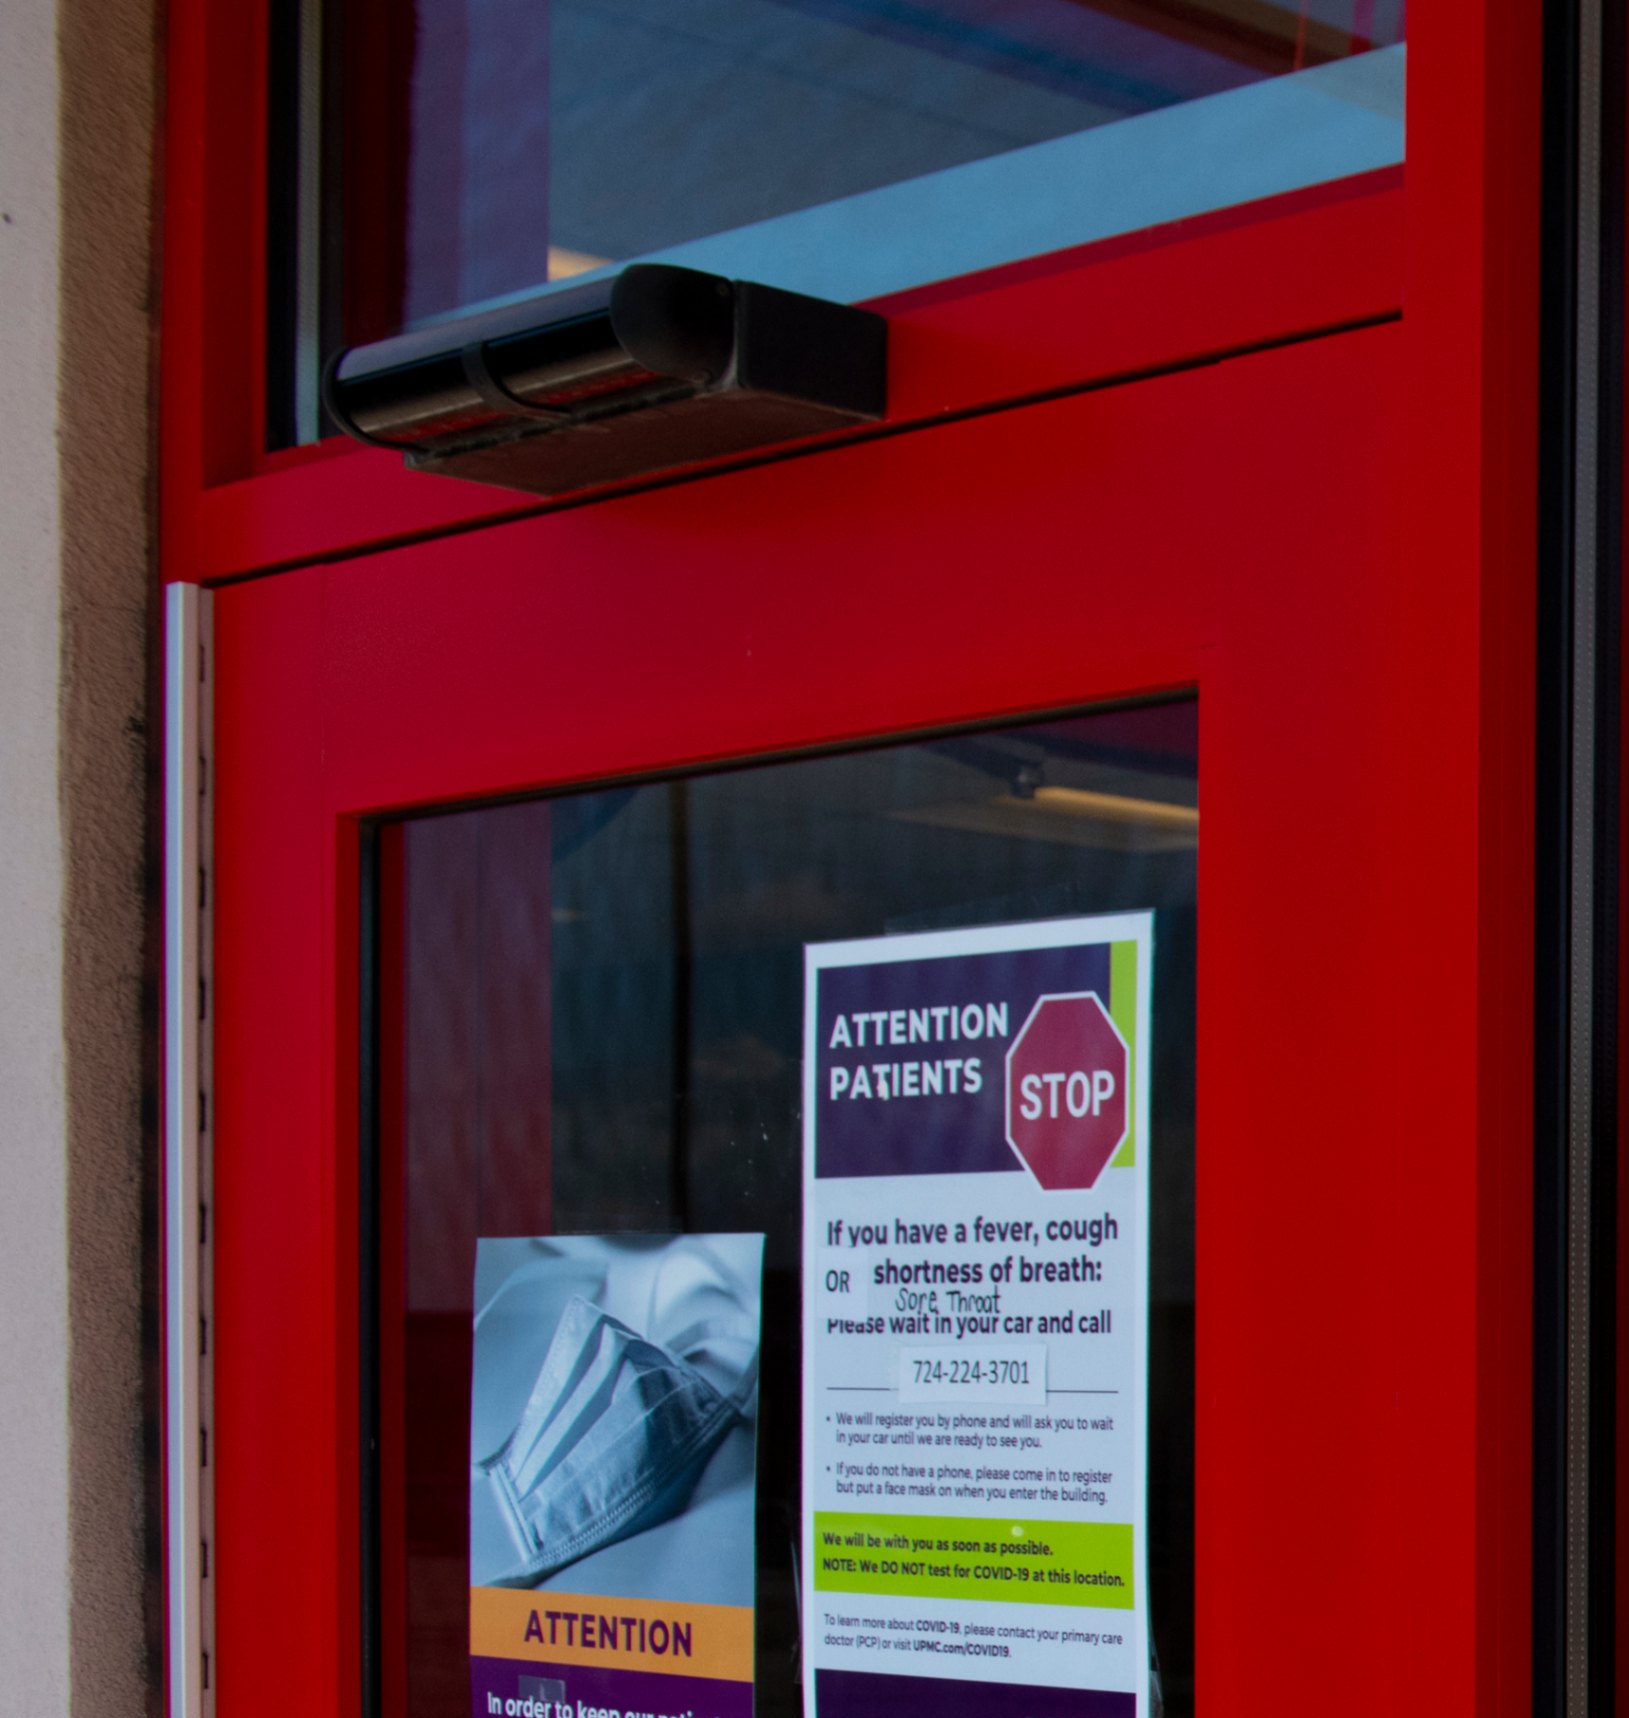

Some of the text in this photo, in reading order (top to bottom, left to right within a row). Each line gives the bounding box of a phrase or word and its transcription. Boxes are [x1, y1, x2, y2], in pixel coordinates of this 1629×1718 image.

[830, 1002, 1007, 1048] ATTENTION
[831, 1058, 982, 1100] PATIENTS
[1020, 1070, 1114, 1120] STOP
[828, 1212, 1117, 1247] If you have a fever, cough
[826, 1270, 850, 1292] OR
[874, 1254, 1101, 1284] shortness of breath:
[895, 1285, 1002, 1314] Sore Throat
[889, 1311, 931, 1335] wait
[935, 1311, 953, 1335] in
[956, 1316, 999, 1339] your
[1003, 1316, 1033, 1334] car
[1037, 1310, 1073, 1334] and
[1077, 1309, 1112, 1334] call
[913, 1360, 1029, 1384] 724-224-3701
[524, 1610, 691, 1657] ATTENTION
[488, 1692, 501, 1714] In
